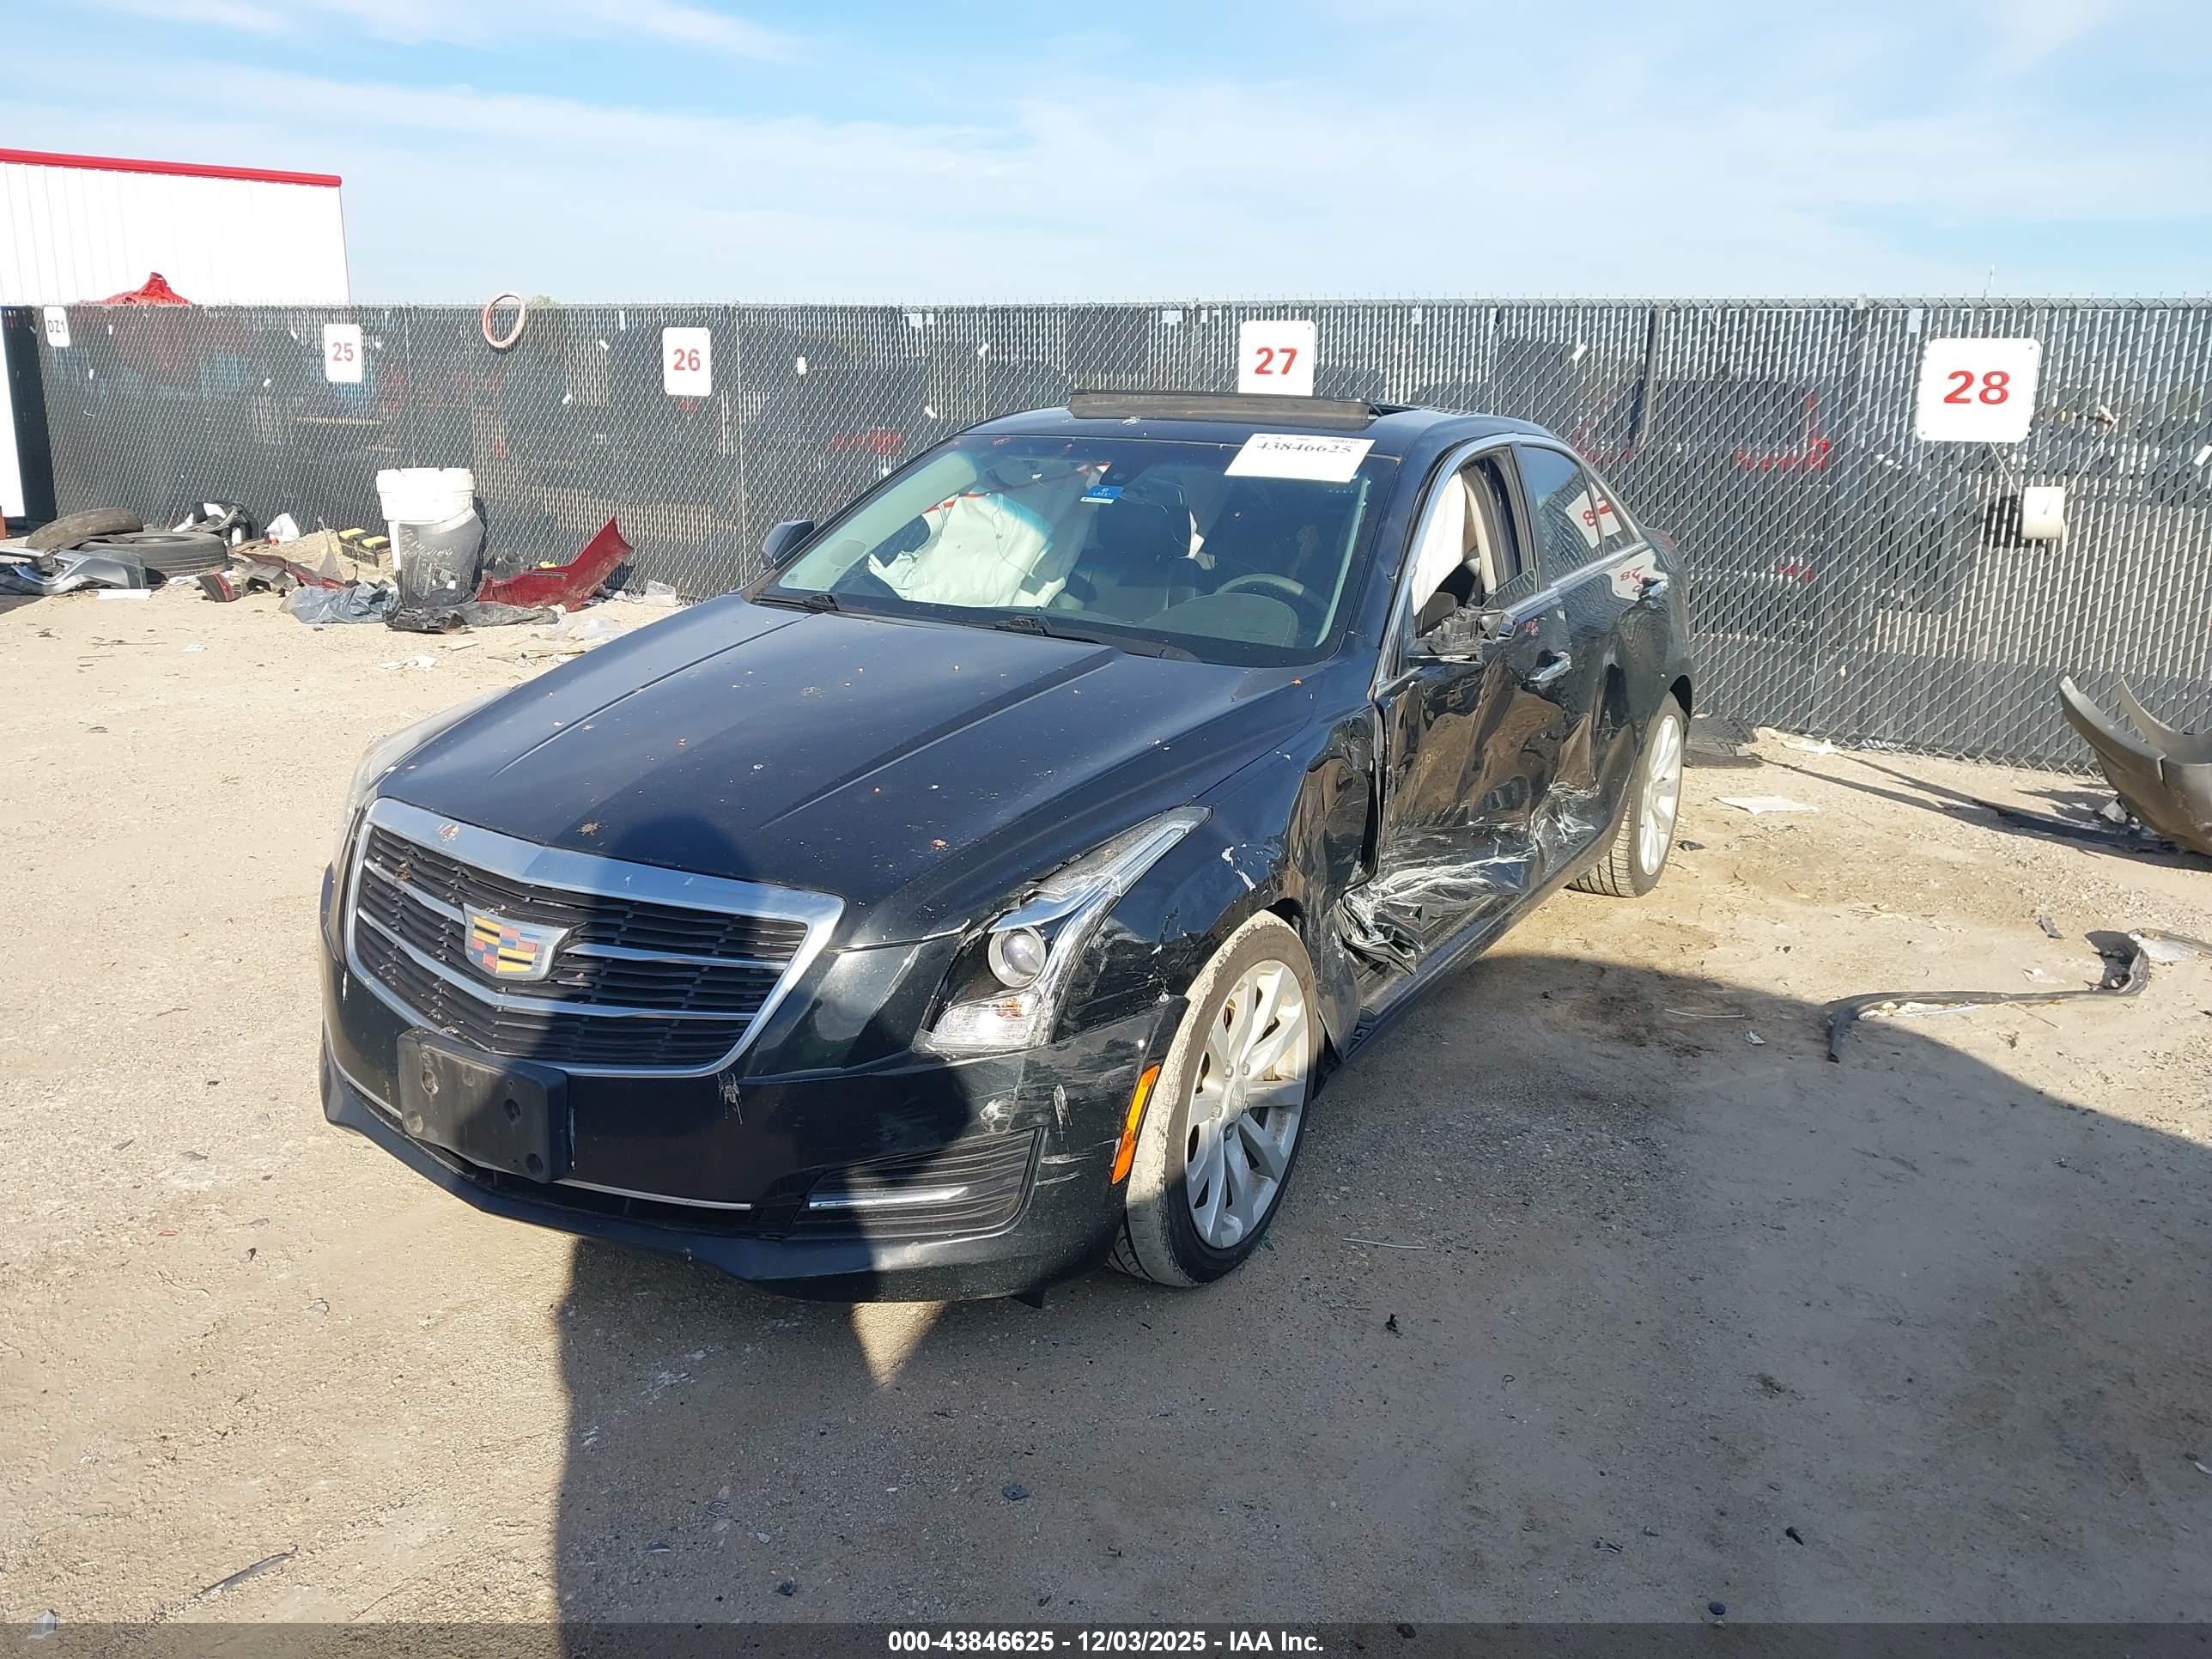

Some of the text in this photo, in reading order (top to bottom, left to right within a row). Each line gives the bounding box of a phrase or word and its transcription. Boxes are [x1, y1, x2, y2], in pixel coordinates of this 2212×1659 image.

[47, 319, 65, 333] DZ1
[332, 342, 354, 362] 25
[673, 348, 701, 371] 26
[1255, 347, 1298, 375] 27
[1943, 370, 2011, 404] 28
